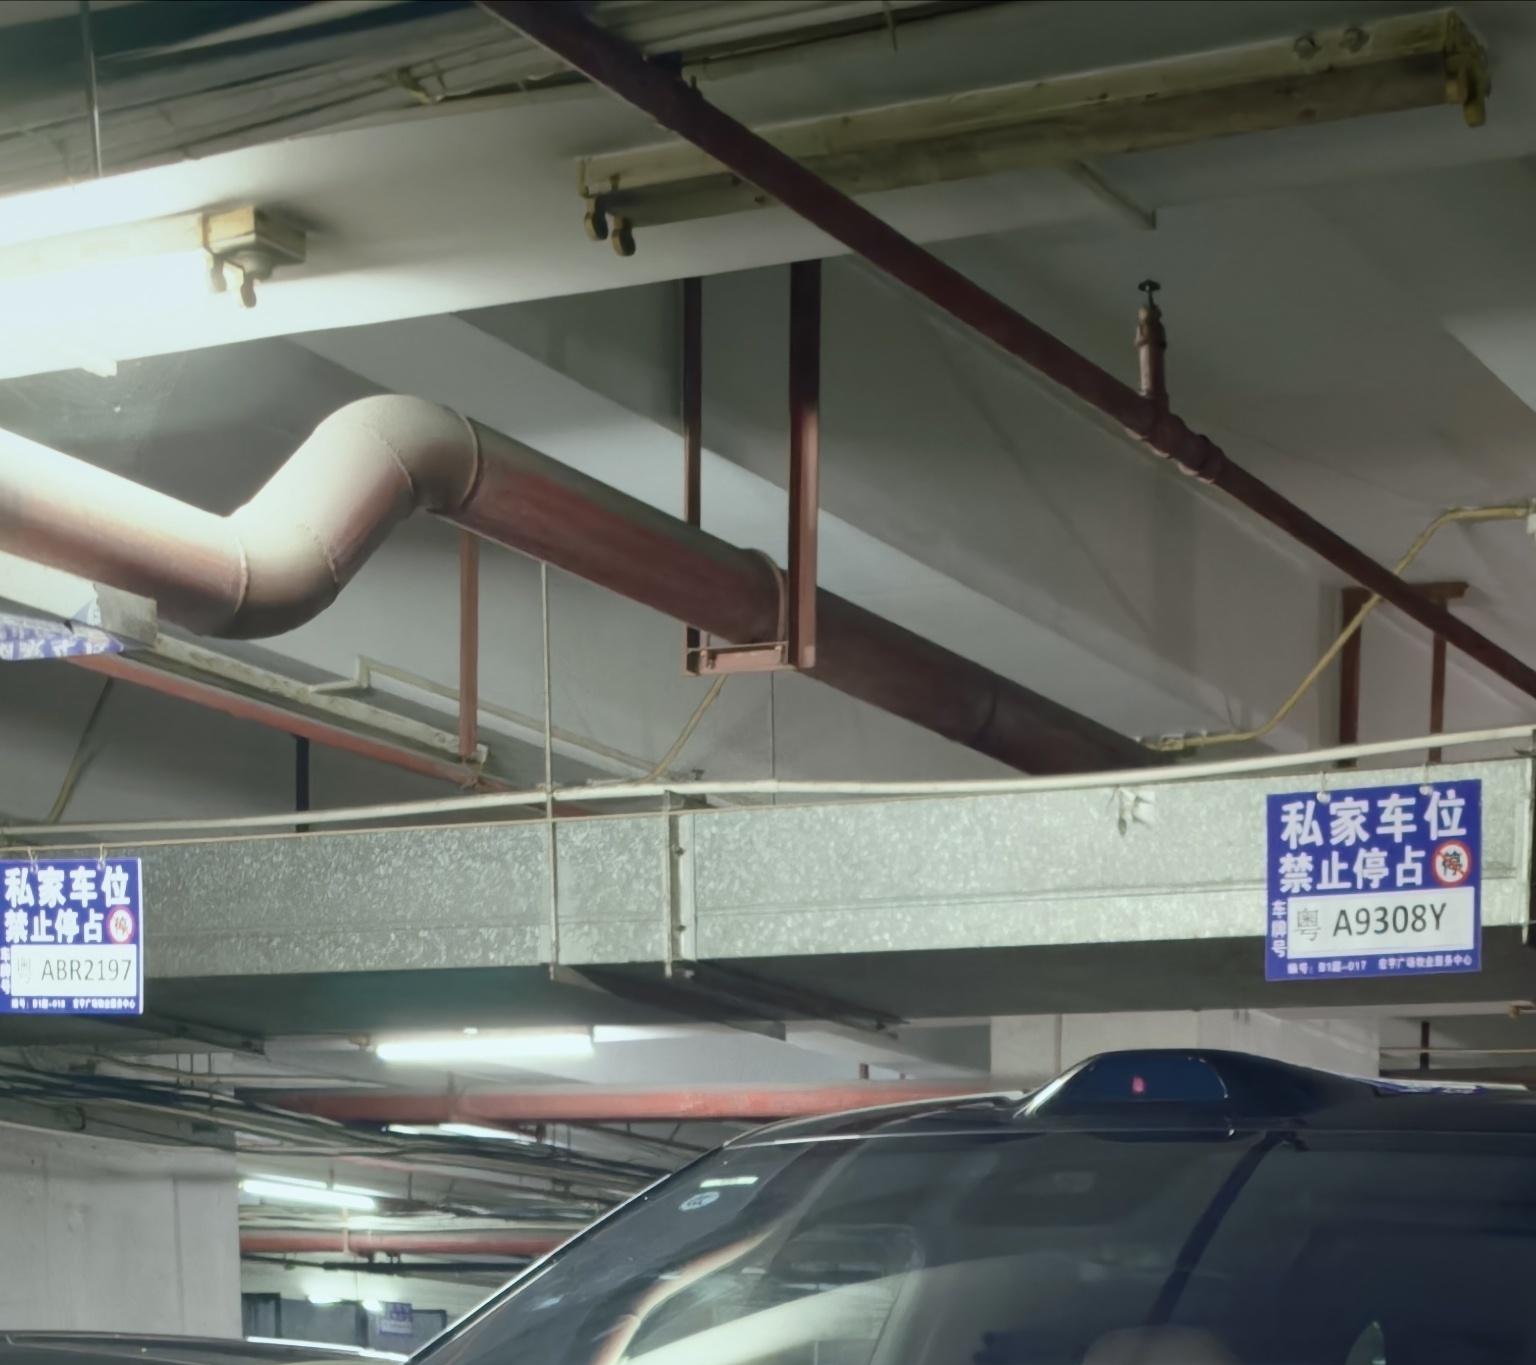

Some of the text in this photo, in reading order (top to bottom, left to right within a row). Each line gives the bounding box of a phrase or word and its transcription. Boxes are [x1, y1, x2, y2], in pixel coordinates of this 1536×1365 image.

[1280, 789, 1467, 849] 私家车位
[4, 865, 131, 909] 私家车位
[1279, 845, 1426, 894] 禁止停占
[4, 908, 104, 944] 禁止停占
[1296, 902, 1447, 942] 粤 A9308Y
[41, 959, 132, 981] ABR2197
